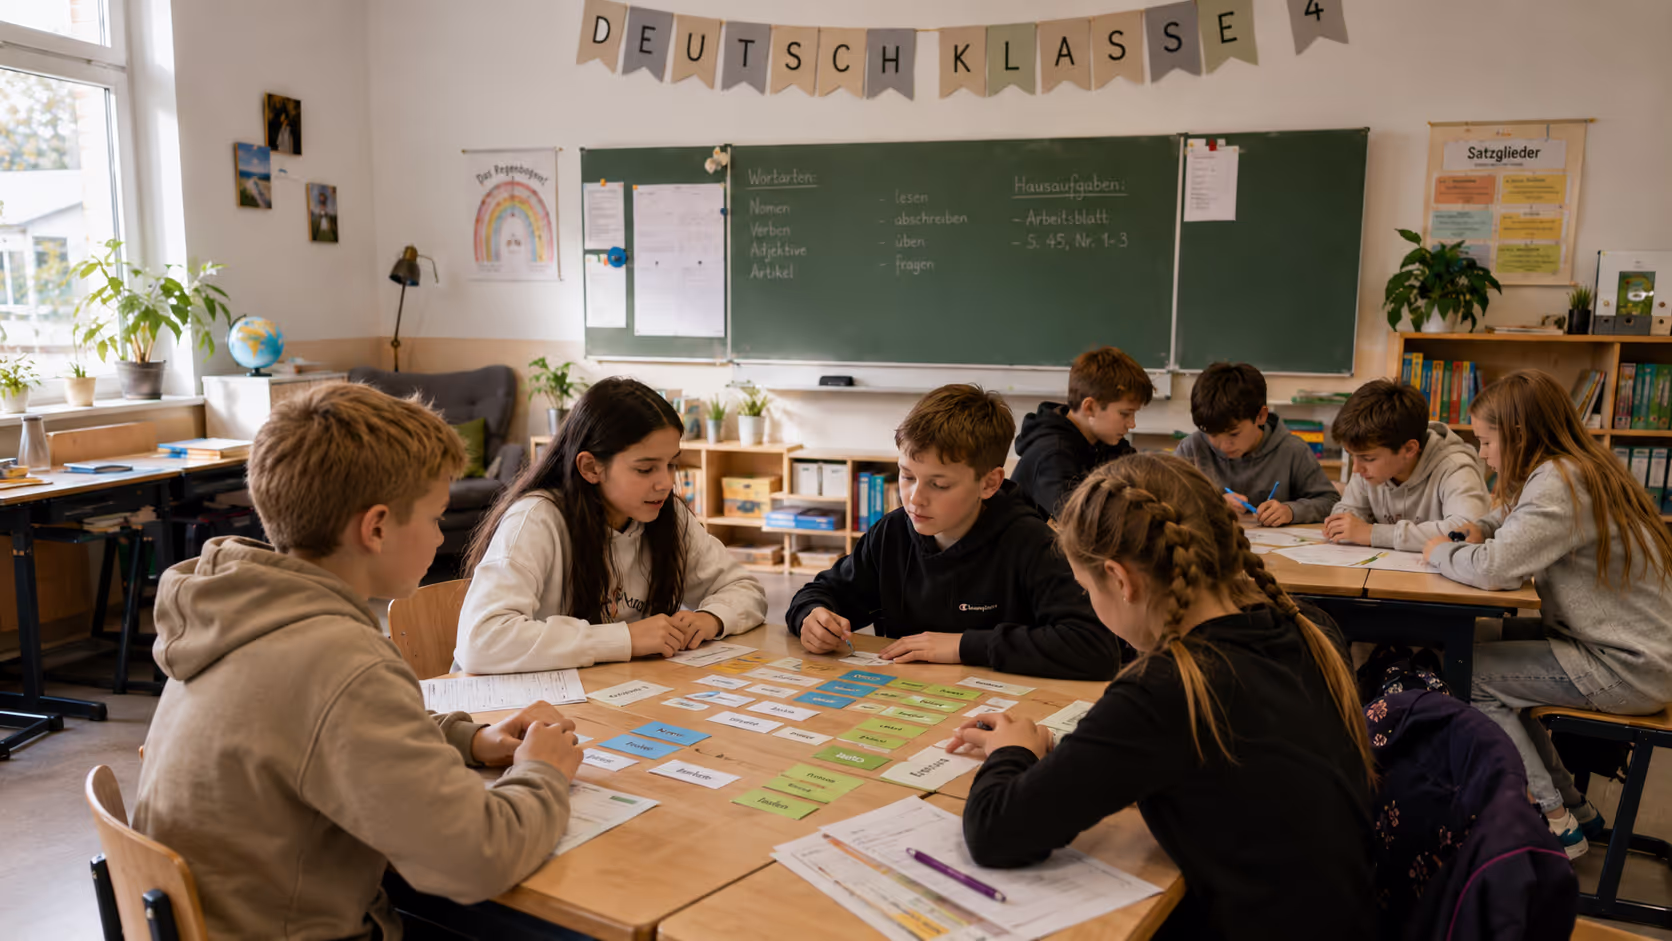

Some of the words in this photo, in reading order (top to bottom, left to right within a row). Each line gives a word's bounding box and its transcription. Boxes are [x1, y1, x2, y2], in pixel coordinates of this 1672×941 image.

[592, 15, 900, 74] DEUTSCH
[953, 11, 1238, 74] KLASSE
[1304, 0, 1325, 21] 4
[1467, 146, 1541, 162] Satzglieder
[476, 170, 492, 184] Das
[748, 168, 817, 185] Wortarten:
[1014, 173, 1126, 201] Hausaufgaben:
[895, 188, 929, 204] lesen
[749, 197, 790, 216] Nomen
[894, 209, 968, 225] abschreiben
[1026, 208, 1109, 226] Arbeitsblatt
[749, 220, 791, 237] Verben
[895, 233, 926, 248] üben
[1026, 233, 1040, 249] S.
[1046, 233, 1070, 251] 45,
[1075, 232, 1096, 248] Nr.
[750, 241, 808, 262] Adjektive
[750, 262, 794, 279] Artikel
[895, 253, 935, 277] fragen
